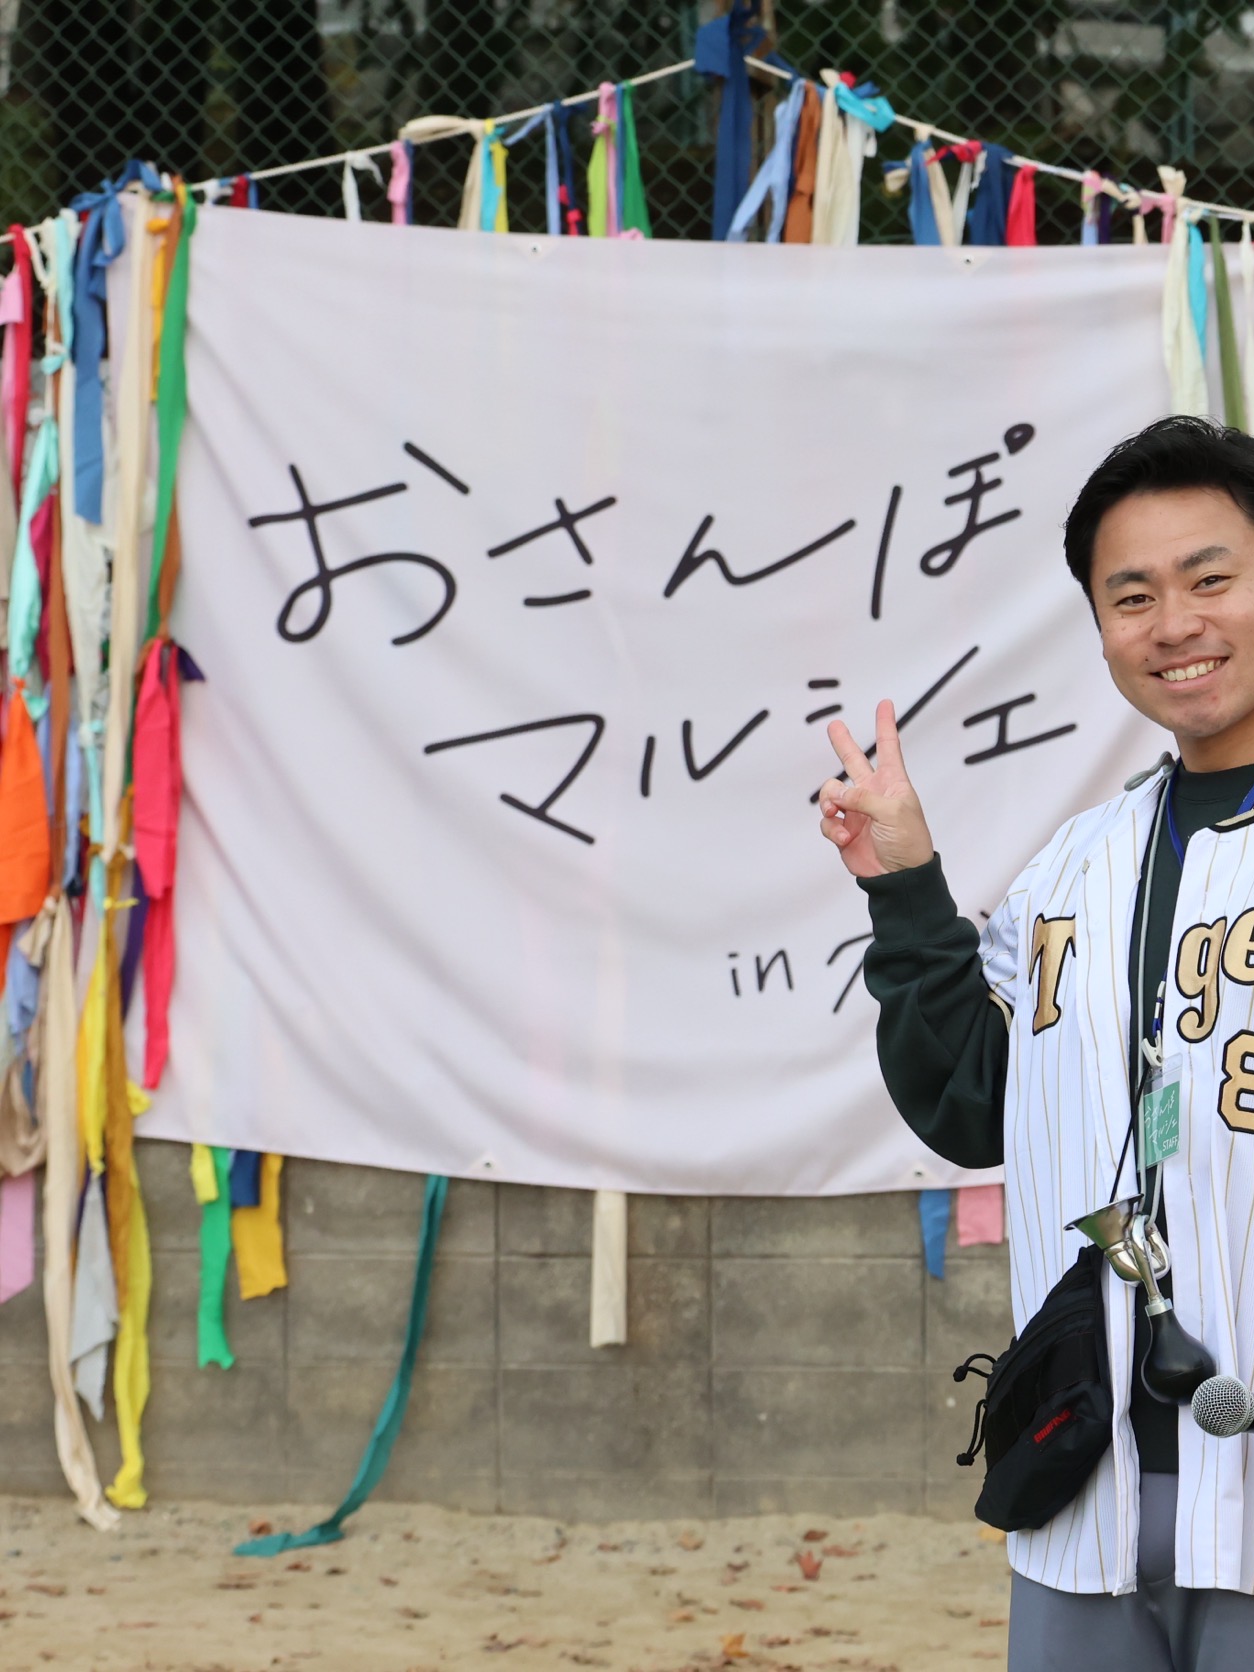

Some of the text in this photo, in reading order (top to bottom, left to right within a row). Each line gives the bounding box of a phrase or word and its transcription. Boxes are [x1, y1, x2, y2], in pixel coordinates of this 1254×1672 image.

[248, 422, 1036, 646] おさんぽ
[424, 646, 1079, 846] マルシェ
[728, 949, 795, 997] in
[1162, 1134, 1180, 1152] STAFF
